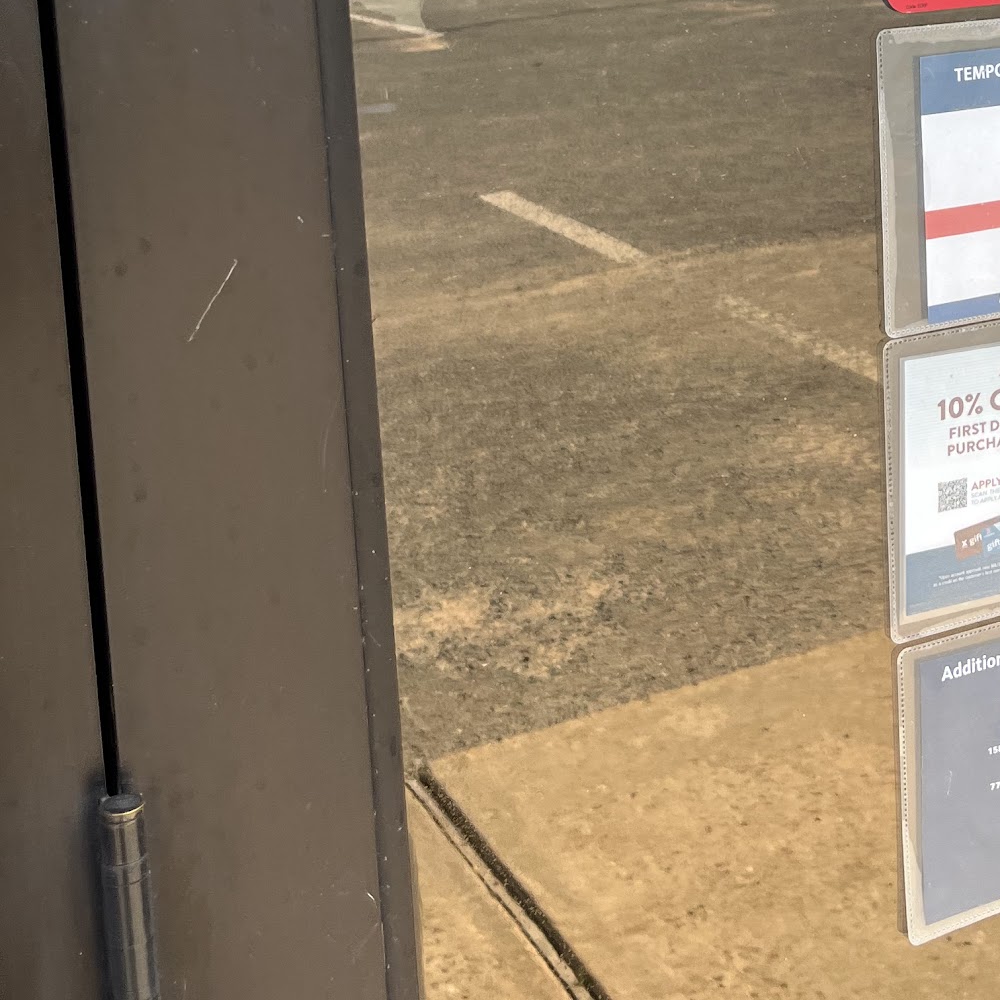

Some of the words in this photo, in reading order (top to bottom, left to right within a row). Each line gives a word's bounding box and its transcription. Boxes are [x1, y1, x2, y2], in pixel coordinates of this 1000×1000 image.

[937, 392, 984, 421] 10%
[949, 422, 988, 439] FIRST
[971, 490, 988, 499] SCAN
[986, 538, 1000, 552] gift
